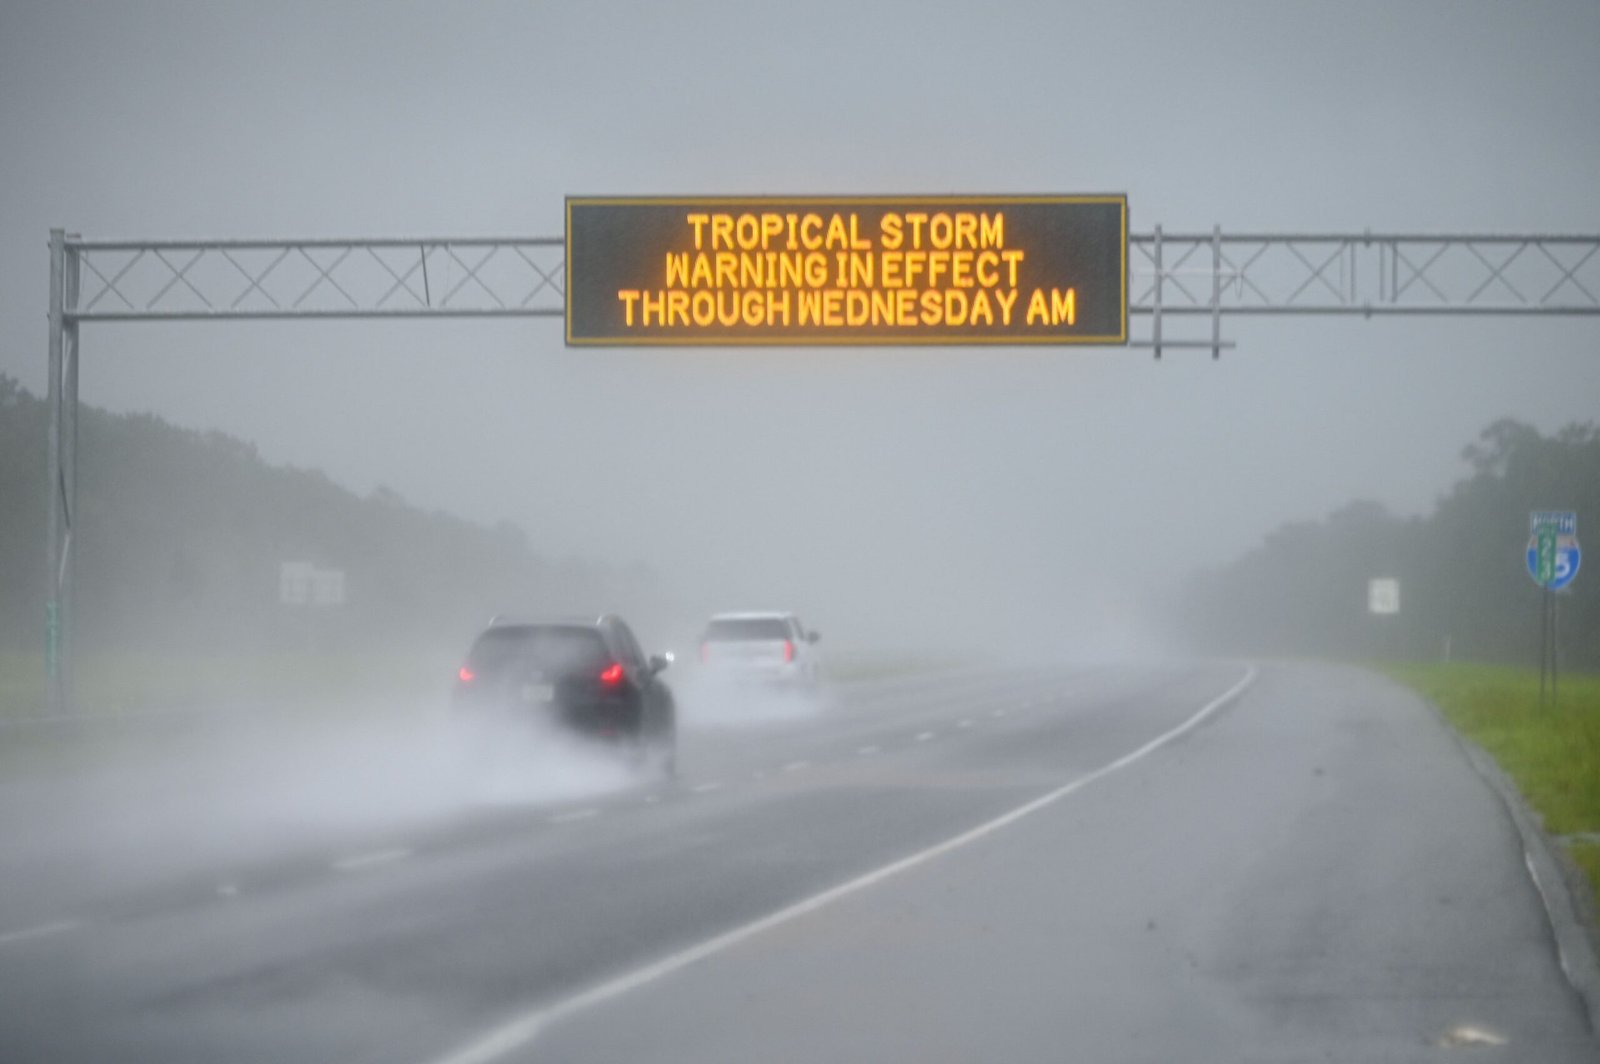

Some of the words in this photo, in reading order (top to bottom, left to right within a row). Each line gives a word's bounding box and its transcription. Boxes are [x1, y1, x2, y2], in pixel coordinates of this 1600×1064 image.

[687, 213, 871, 250] TROPICAL
[880, 213, 1003, 249] STORM
[665, 251, 828, 288] WARNING
[836, 251, 874, 287] IN
[881, 250, 1024, 287] EFFECT
[618, 289, 790, 326] THROUGH
[798, 288, 1017, 326] WEDNESDAY
[1026, 288, 1076, 325] AM
